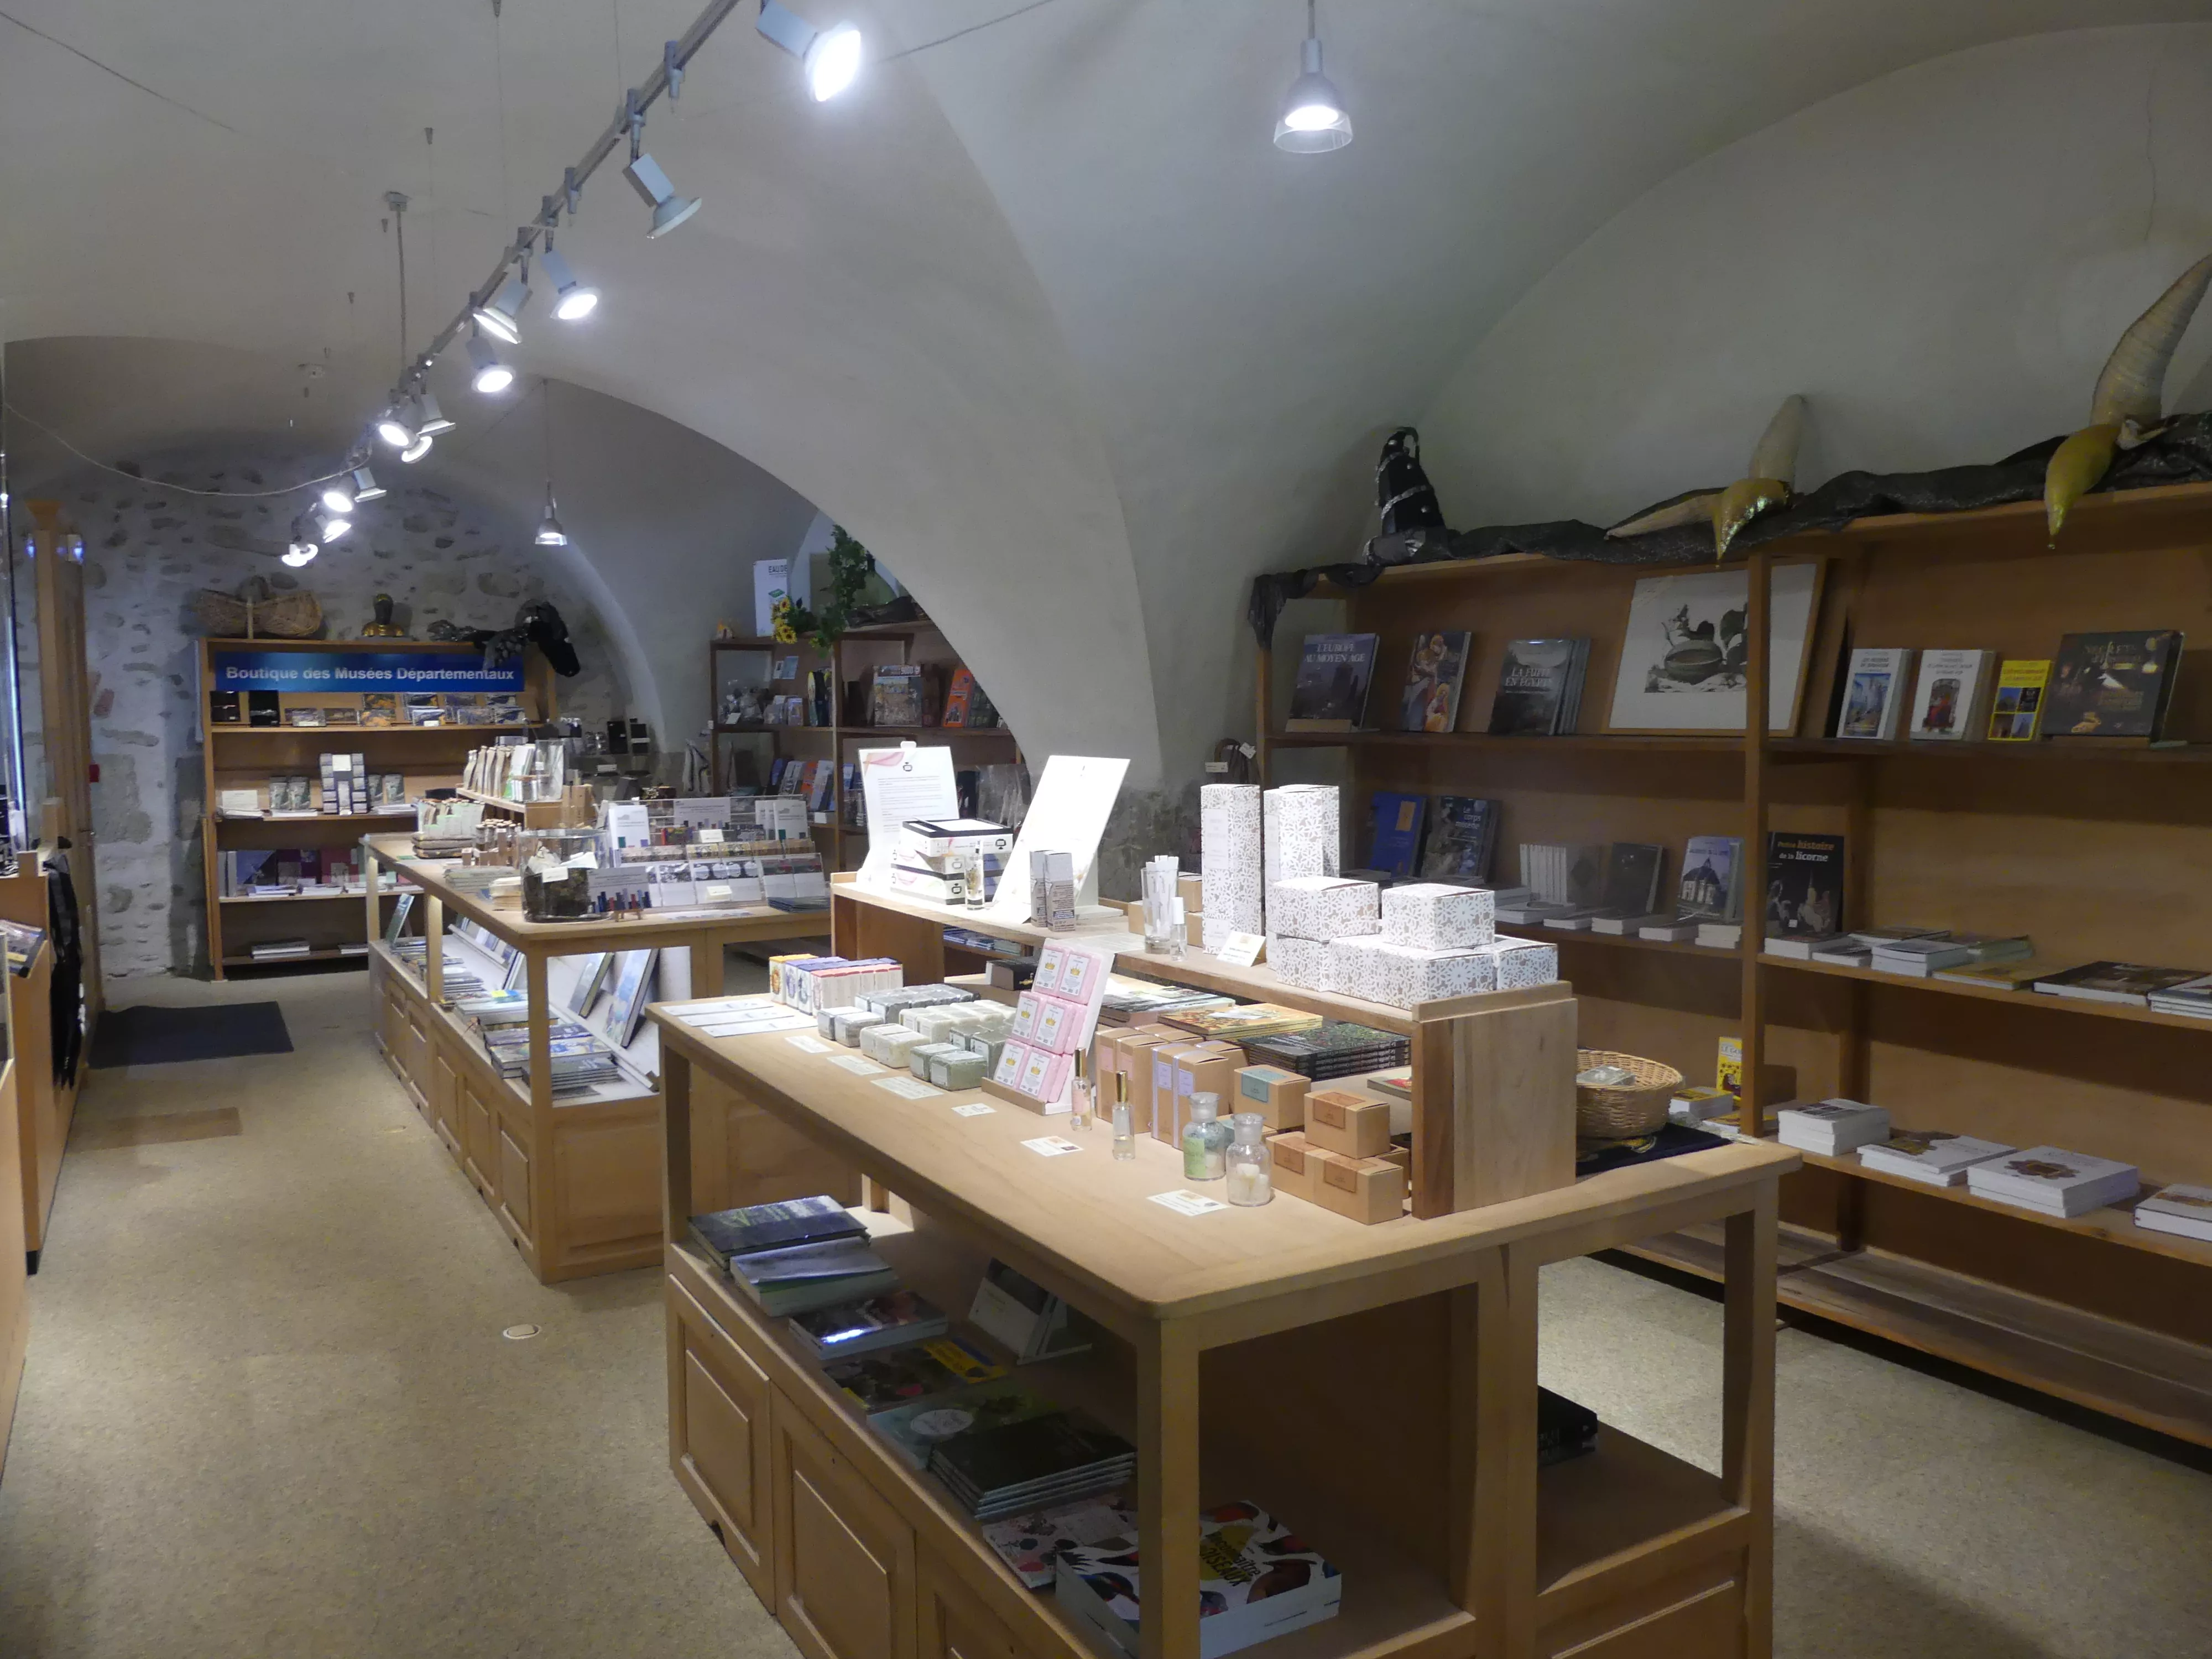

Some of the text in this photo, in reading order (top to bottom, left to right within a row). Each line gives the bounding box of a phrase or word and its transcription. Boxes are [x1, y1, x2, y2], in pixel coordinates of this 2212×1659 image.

[1305, 654, 1316, 662] AU
[1316, 654, 1348, 662] MOYEN
[226, 666, 514, 682] Boutique des Musées Départementaux
[1464, 814, 1481, 823] corps
[1797, 839, 1835, 851] histoire
[1795, 851, 1829, 862] licorne
